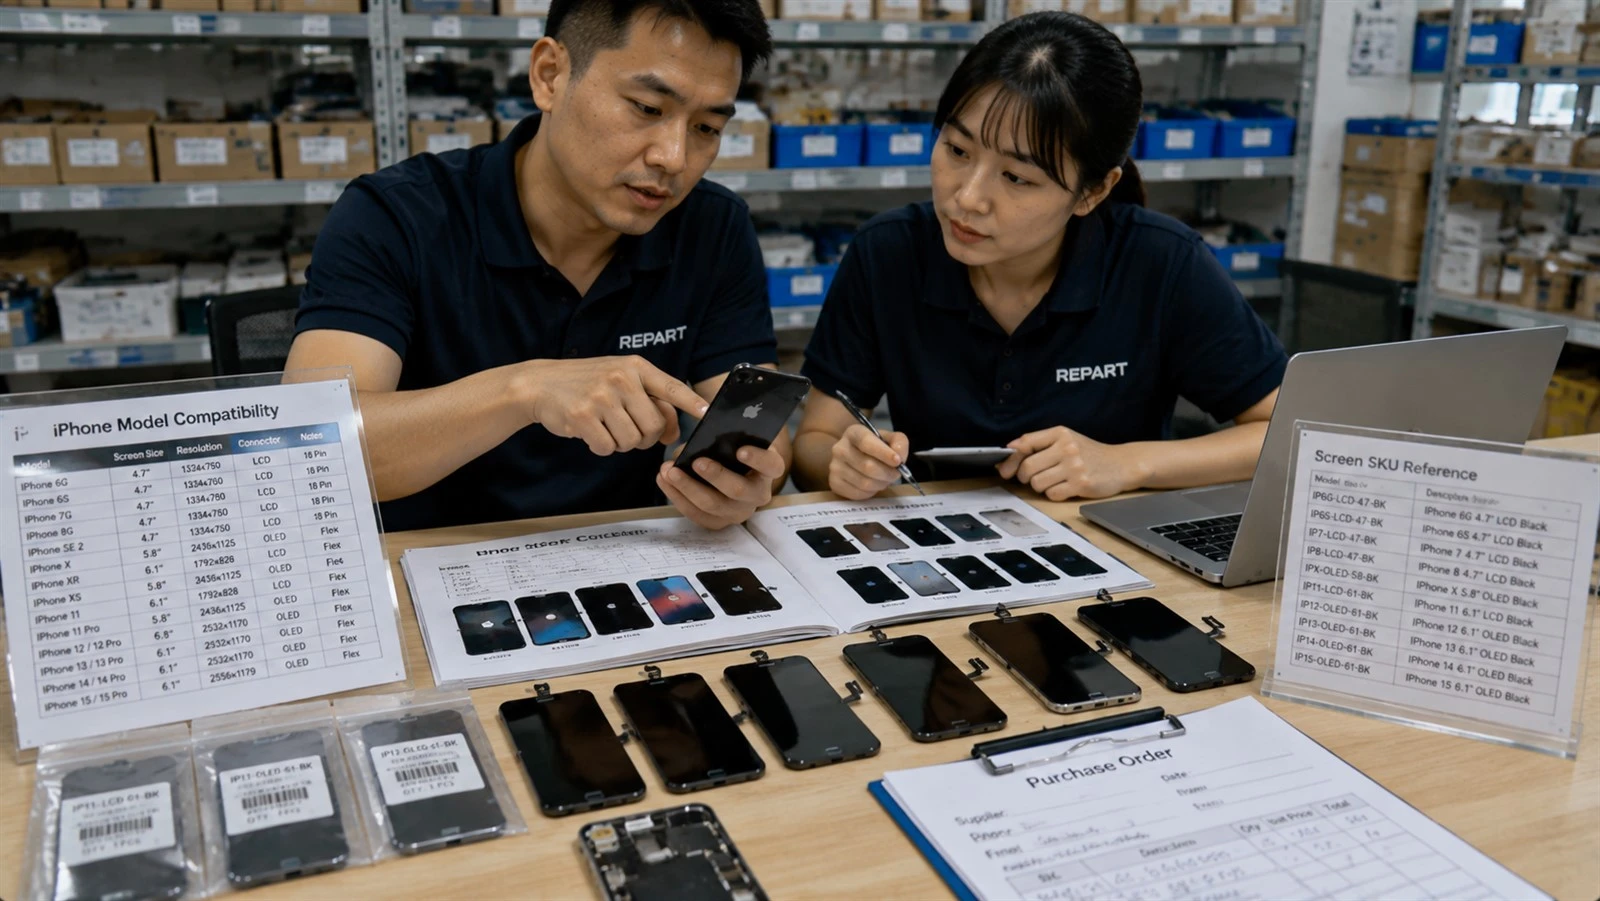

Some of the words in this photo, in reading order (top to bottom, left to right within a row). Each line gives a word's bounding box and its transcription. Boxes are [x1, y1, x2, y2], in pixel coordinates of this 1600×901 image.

[619, 325, 687, 349] REPART
[1056, 362, 1128, 382] REPART
[53, 422, 112, 438] iPhone
[117, 414, 168, 431] Model
[174, 403, 279, 426] Compatibility
[252, 455, 271, 465] LCD
[1315, 450, 1363, 467] Screen
[1368, 457, 1399, 471] SKU
[1403, 461, 1478, 481] Reference
[254, 471, 273, 480] LCD
[257, 487, 276, 496] LCD
[259, 502, 278, 512] LCD
[262, 517, 281, 527] LCD
[1496, 516, 1517, 527] LCD
[262, 532, 286, 543] OLED
[1493, 535, 1514, 546] LCD
[267, 548, 286, 558] LCD
[1488, 553, 1510, 565] LCD
[268, 563, 292, 574] OLED
[1485, 573, 1507, 584] LCD
[272, 579, 291, 590] LCD
[273, 594, 297, 605] OLED
[276, 610, 300, 621] OLED
[1482, 610, 1504, 622] LCD
[279, 626, 303, 637] OLED
[282, 641, 306, 653] OLED
[284, 657, 309, 669] OLED
[1026, 762, 1116, 789] Purchase
[1119, 748, 1173, 767] Order
